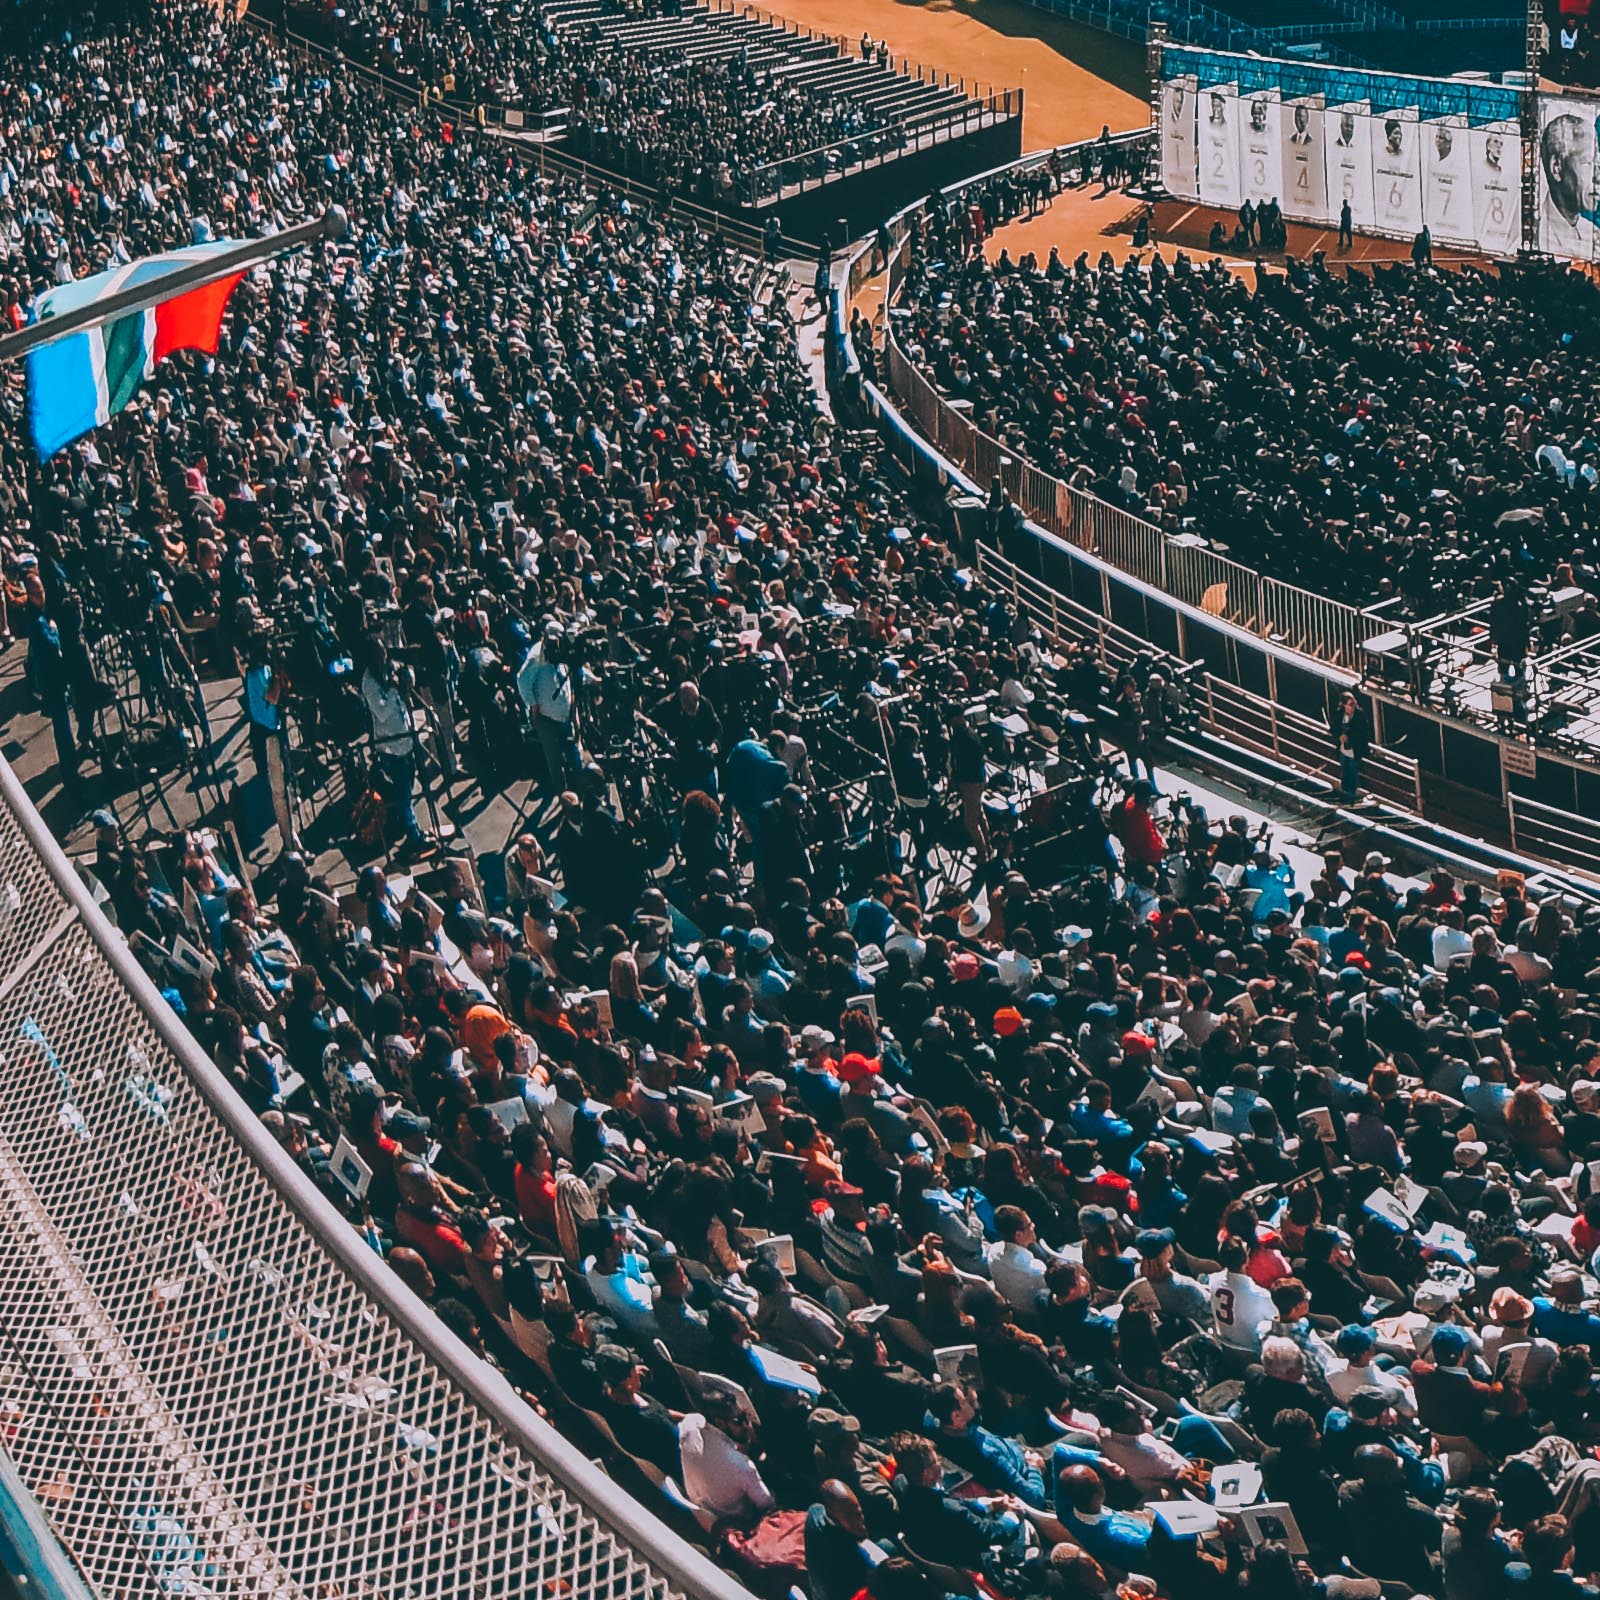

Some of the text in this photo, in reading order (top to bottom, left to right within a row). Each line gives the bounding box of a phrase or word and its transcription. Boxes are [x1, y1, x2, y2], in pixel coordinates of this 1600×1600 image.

[1212, 152, 1224, 178] 2
[1254, 160, 1265, 186] 3
[1297, 166, 1310, 192] 4
[1389, 182, 1402, 208] 6
[1439, 188, 1451, 216] 7
[1491, 196, 1504, 224] 8
